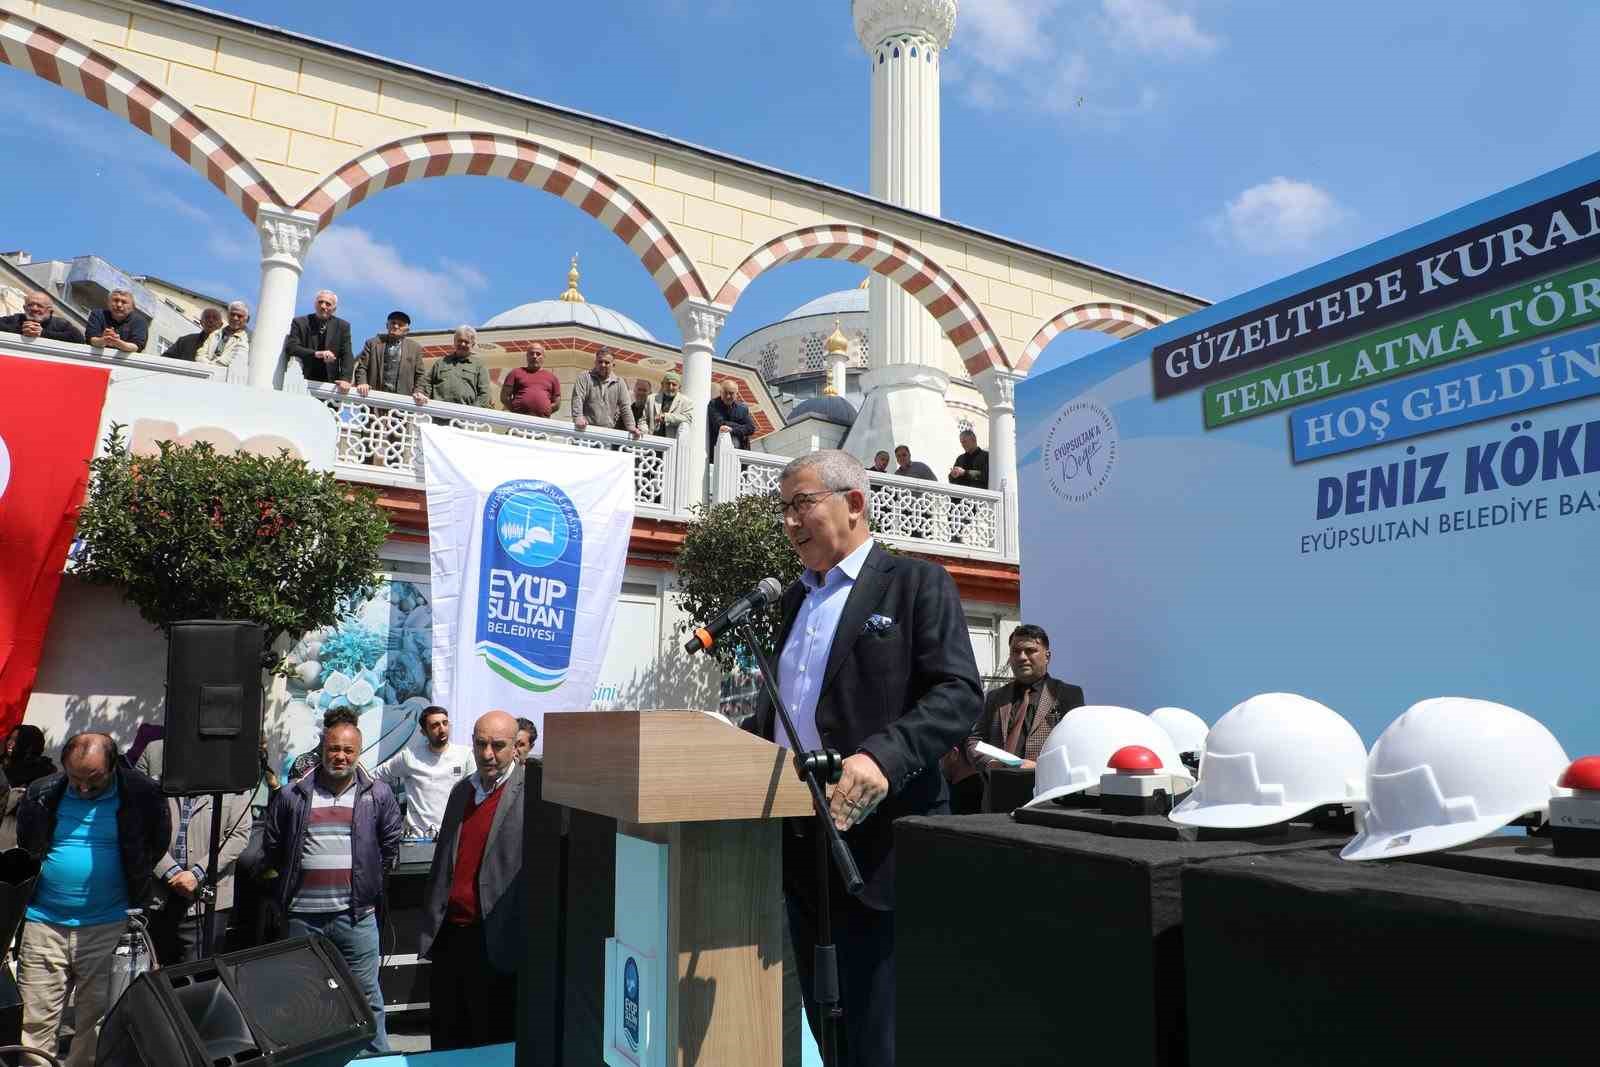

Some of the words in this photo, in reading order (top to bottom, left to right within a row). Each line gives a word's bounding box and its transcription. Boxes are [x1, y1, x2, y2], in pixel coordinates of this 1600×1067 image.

[1165, 268, 1406, 379] GÜZELTEPE
[1216, 360, 1342, 418] TEMEL
[1351, 317, 1483, 381] ATMA
[1490, 278, 1600, 338] TÖR
[1304, 399, 1392, 447] HOŞ
[1316, 445, 1450, 520] DENİZ
[1300, 516, 1429, 553] EYÜPSULTAN
[1439, 497, 1548, 534] BELEDİYE
[1559, 489, 1600, 516] BA
[487, 597, 565, 630] SULTAN
[489, 568, 567, 607] EYÜP
